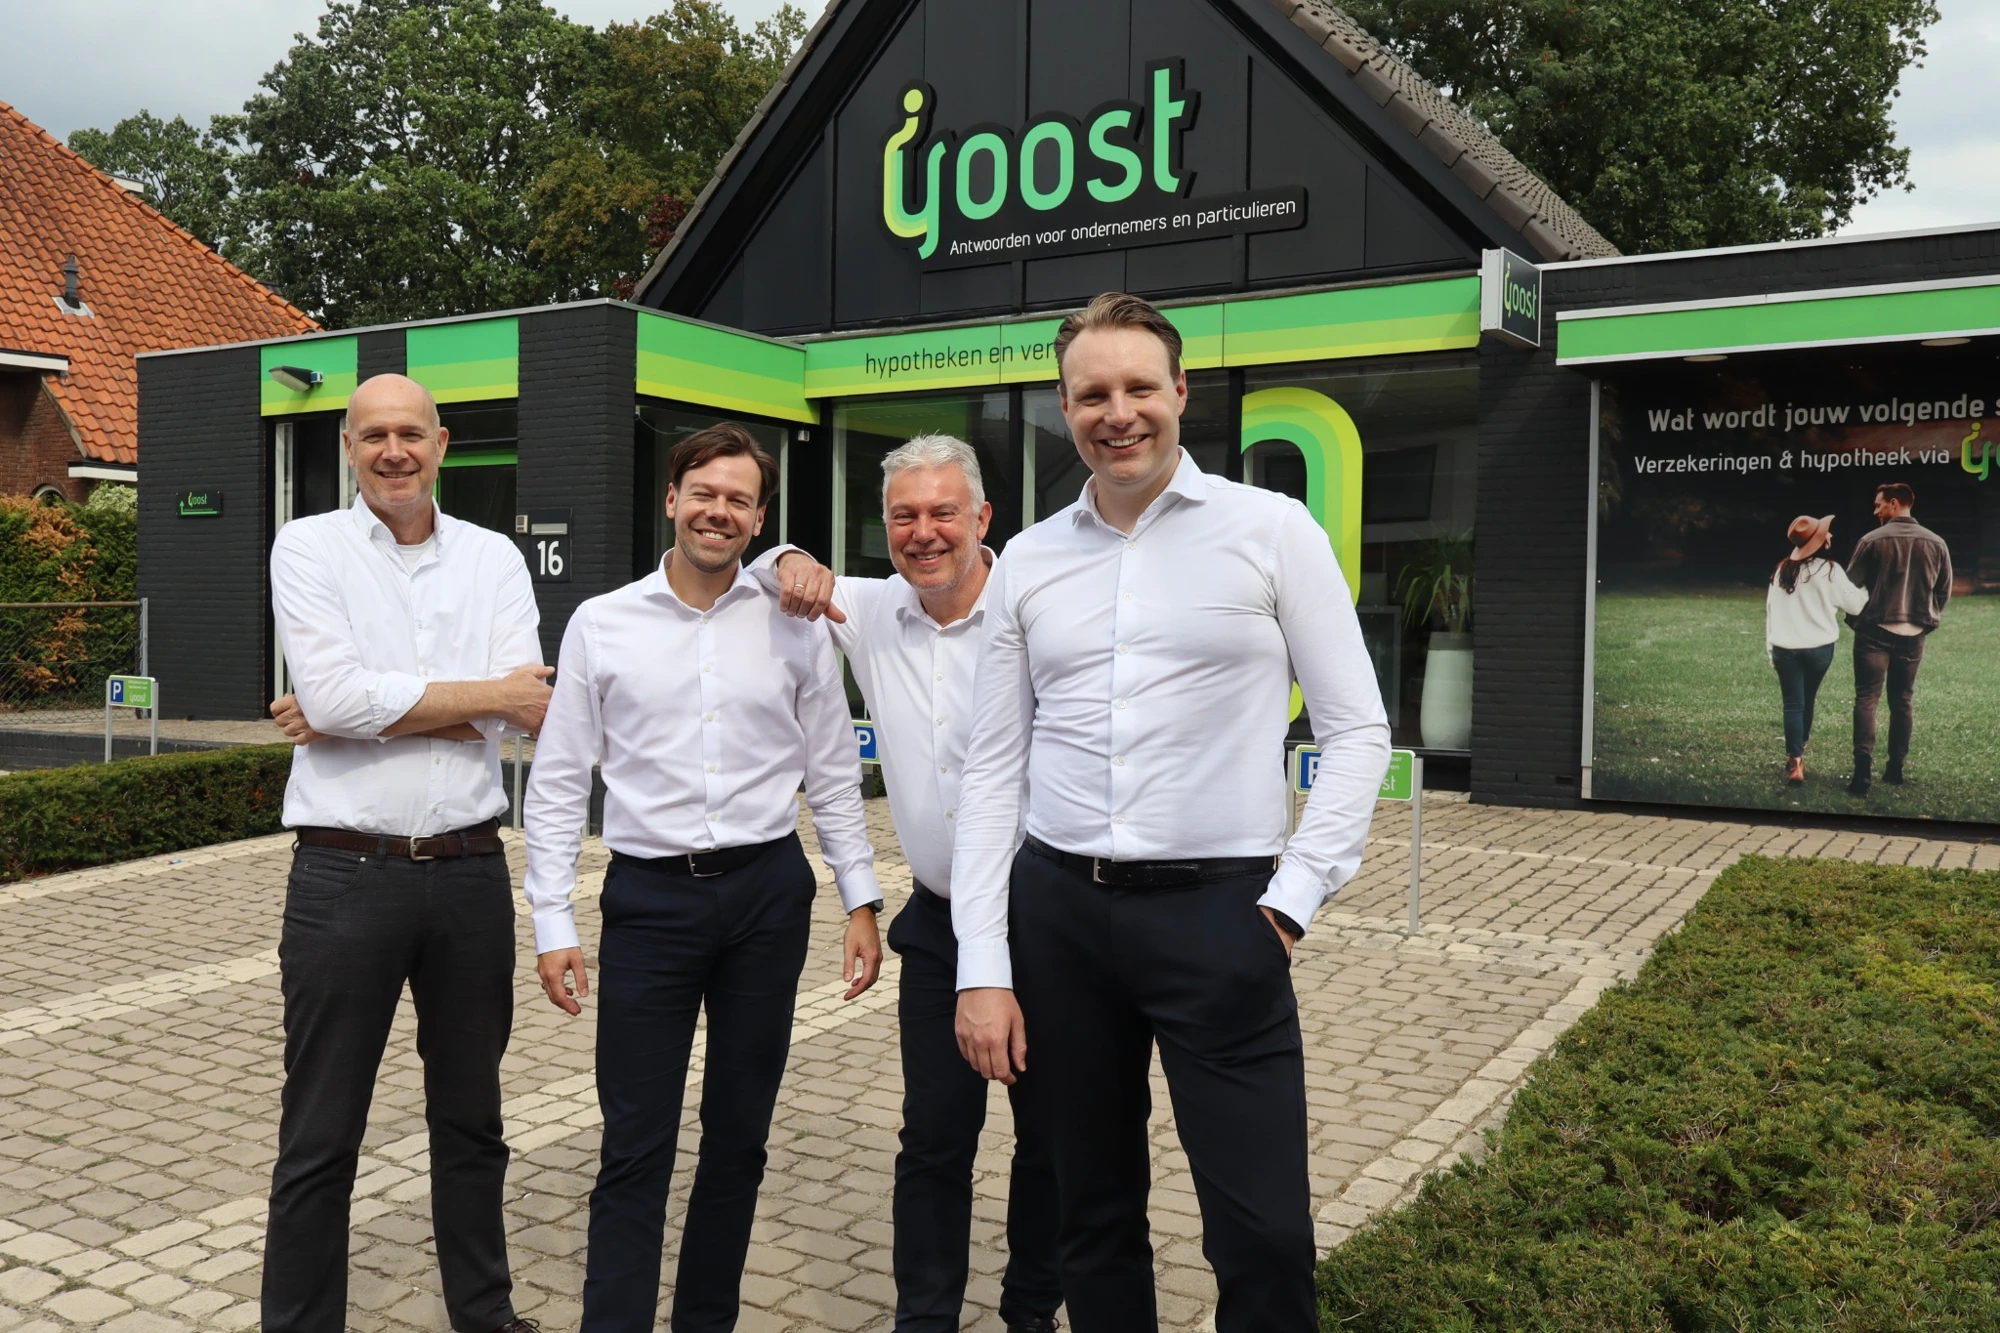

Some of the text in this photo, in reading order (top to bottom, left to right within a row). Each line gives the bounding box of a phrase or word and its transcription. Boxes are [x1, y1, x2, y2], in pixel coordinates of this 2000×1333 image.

[950, 200, 1296, 256] Antwoorden voor ondernemers en particulieren
[865, 342, 1055, 379] hypotheken en ver
[1648, 408, 1695, 432] Wat
[1702, 404, 1776, 430] wordt
[1784, 402, 1851, 432] jouw
[1858, 393, 1985, 427] volgende
[1634, 444, 1950, 475] Verzekeringen & hypotheek via
[537, 540, 564, 576] 16
[112, 681, 122, 700] P
[857, 729, 872, 748] P
